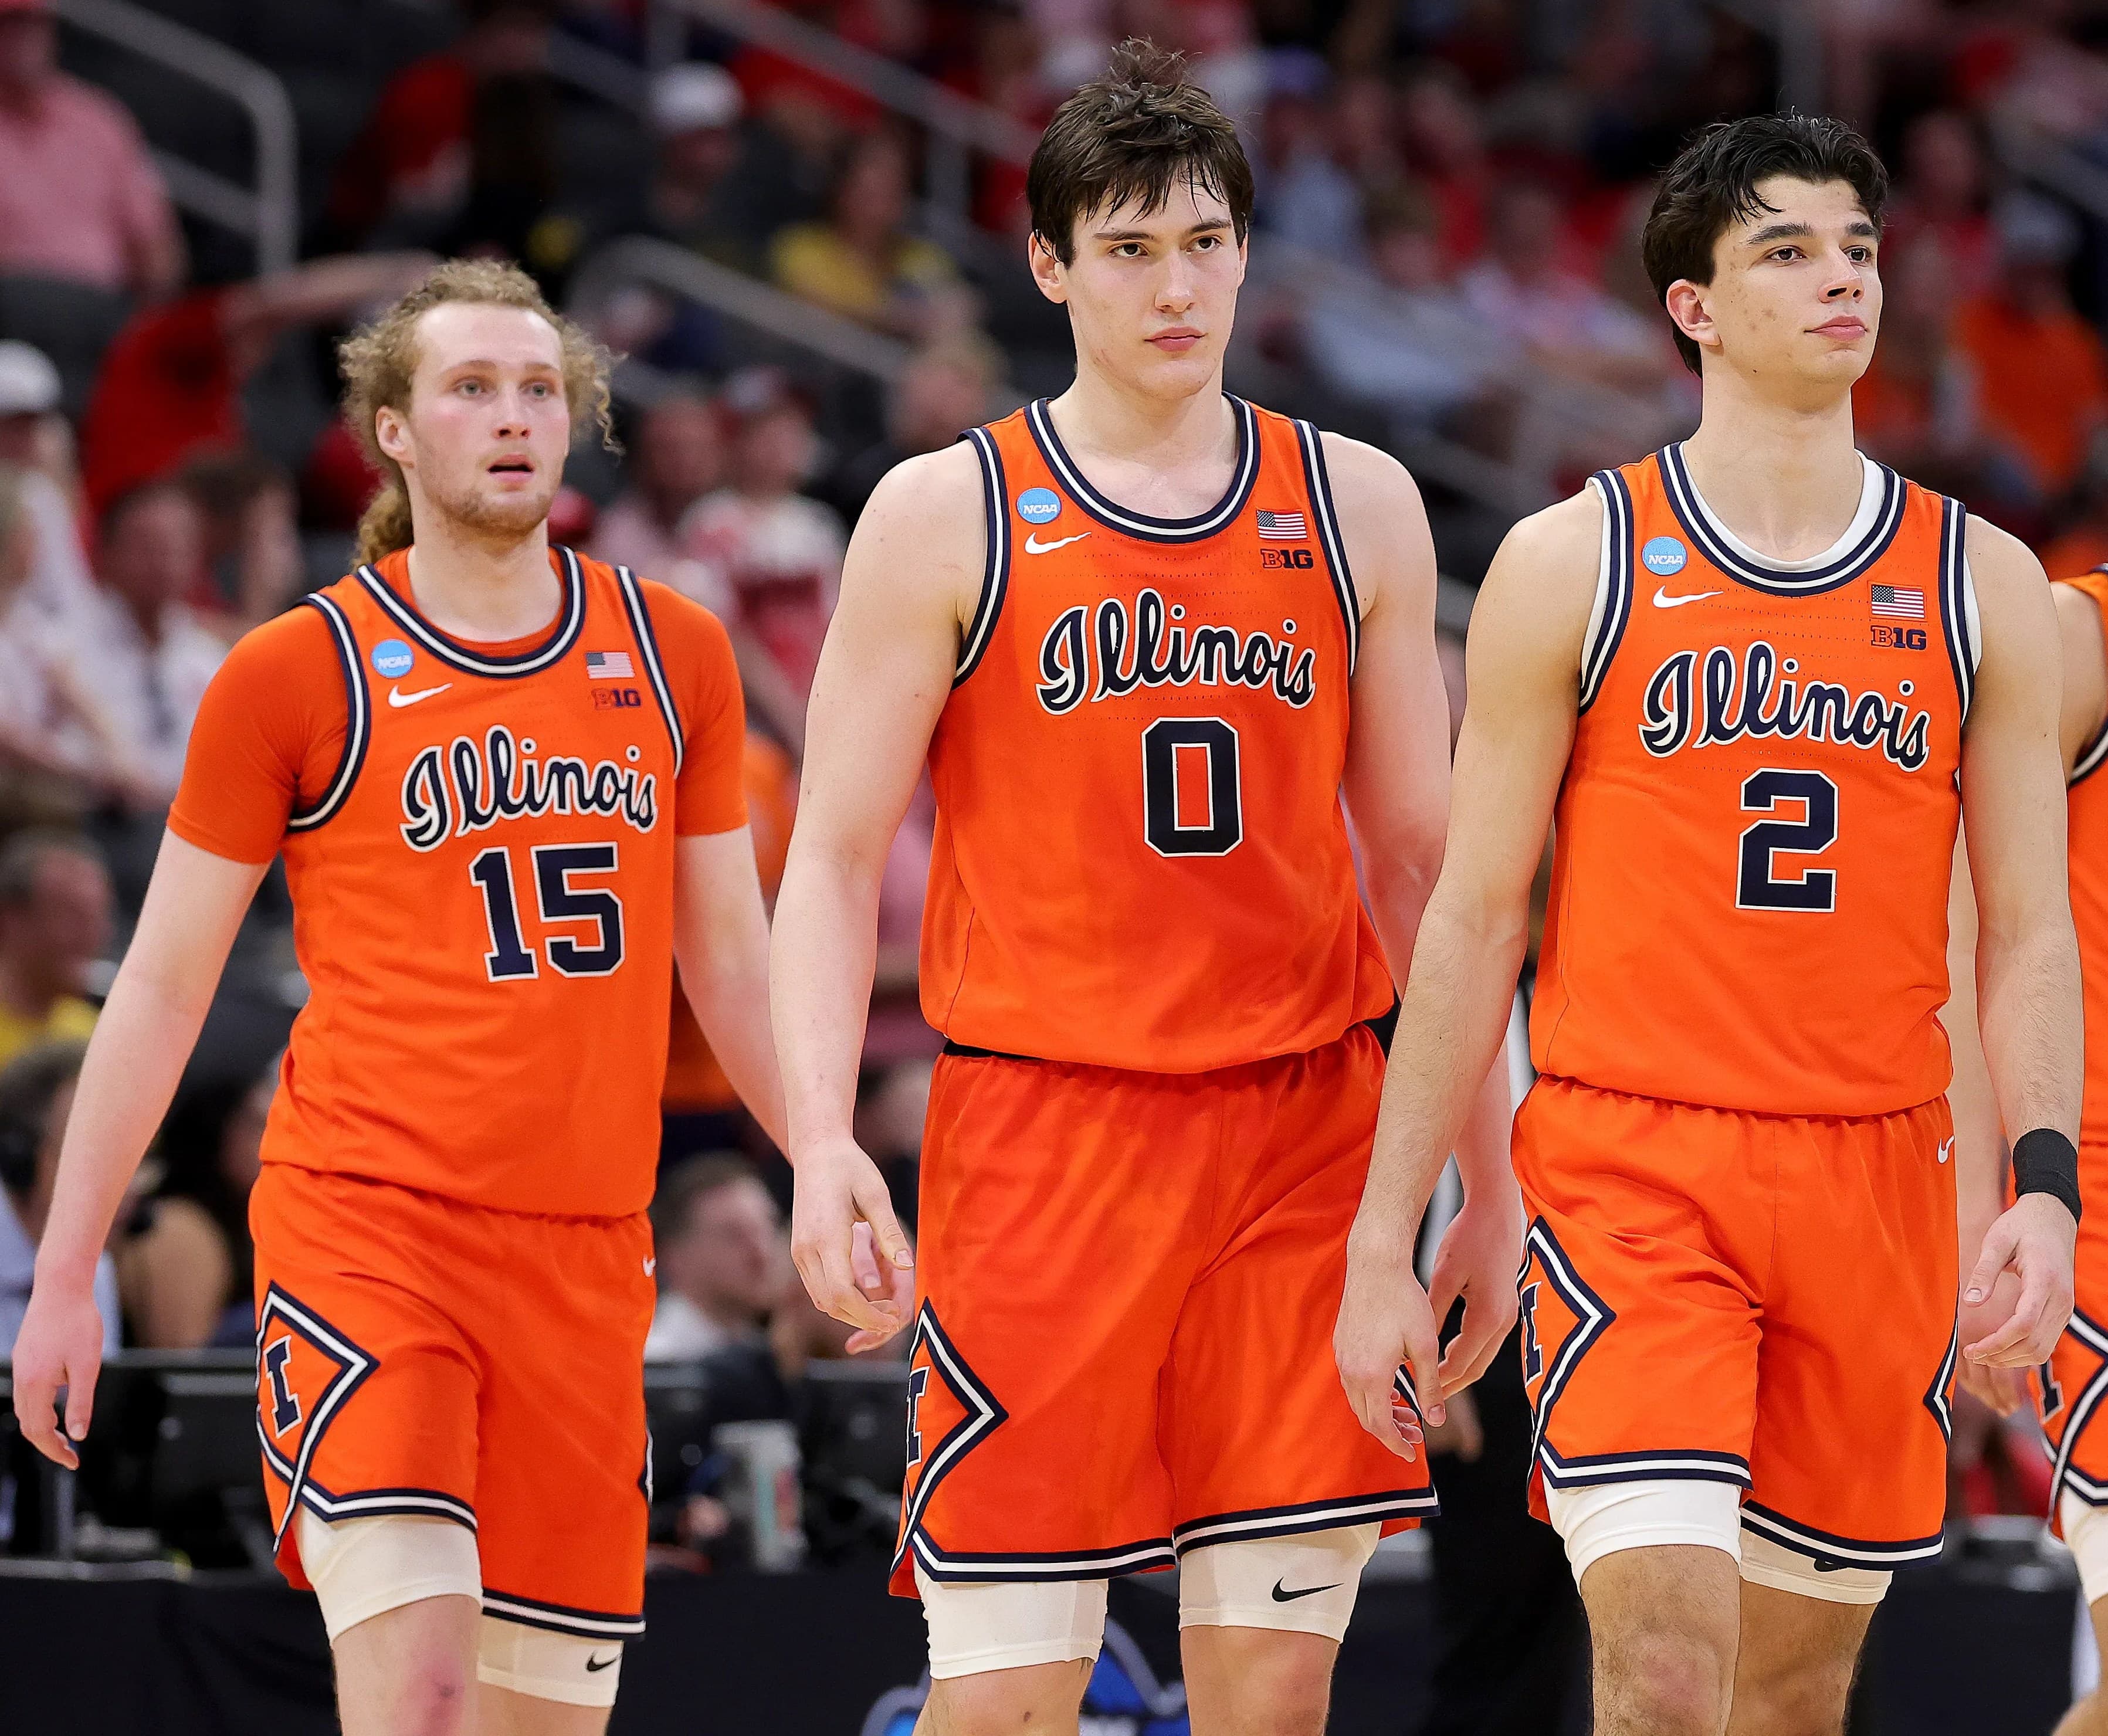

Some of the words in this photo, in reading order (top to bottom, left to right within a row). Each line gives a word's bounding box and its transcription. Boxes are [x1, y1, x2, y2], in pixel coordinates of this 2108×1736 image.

[1023, 503, 1058, 514] NCAA
[1648, 554, 1683, 565] NCAA
[1035, 588, 1316, 715] Illinois
[1638, 640, 1930, 772] Illinois
[399, 724, 658, 853] Illinois
[1141, 717, 1243, 857] 0
[1734, 768, 1839, 913] 2
[469, 841, 625, 982] 15
[263, 1334, 303, 1439] I
